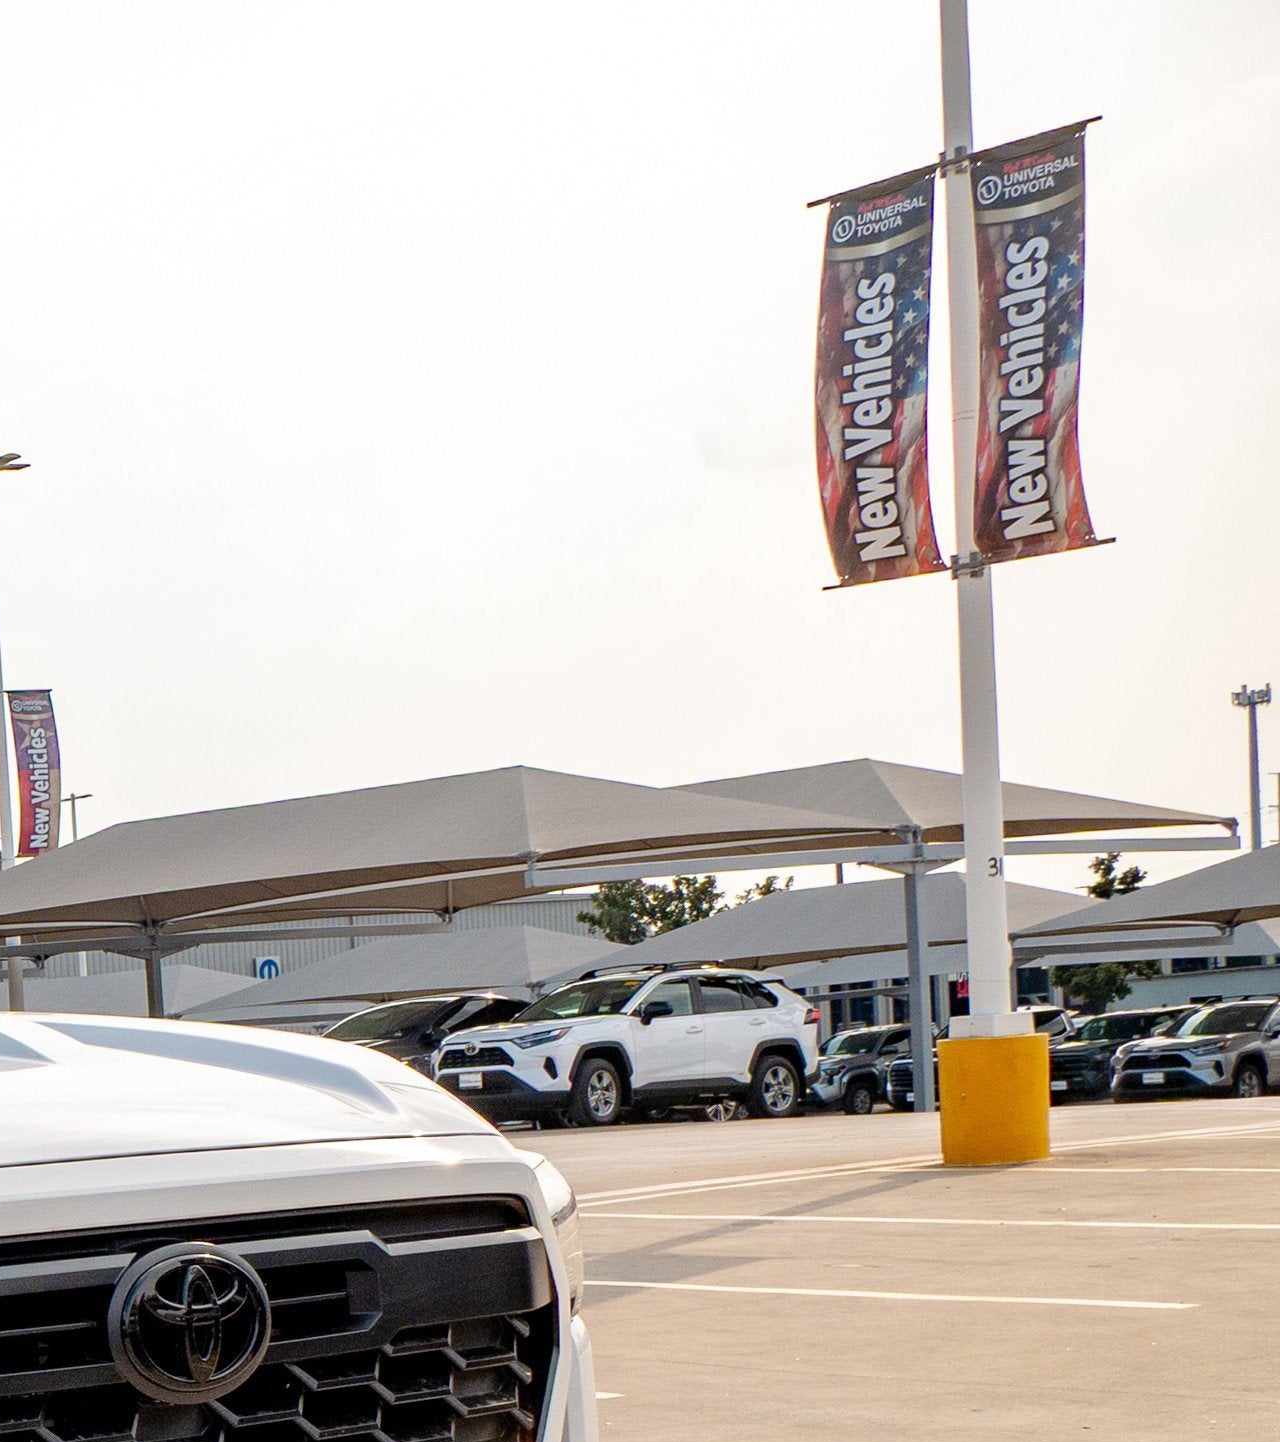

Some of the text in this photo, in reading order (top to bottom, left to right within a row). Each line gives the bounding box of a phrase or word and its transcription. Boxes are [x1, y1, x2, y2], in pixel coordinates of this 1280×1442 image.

[1003, 155, 1080, 186] UNIVERSAL
[1003, 175, 1055, 200] TOYOTA
[856, 215, 902, 238] TOYOTA
[857, 195, 928, 225] UNIVERSAL
[999, 236, 1050, 433] Vehicles
[842, 272, 896, 461] Vehicles
[854, 466, 907, 562] New
[1000, 439, 1055, 541] New
[27, 727, 50, 805] Vehicles
[29, 807, 50, 849] New
